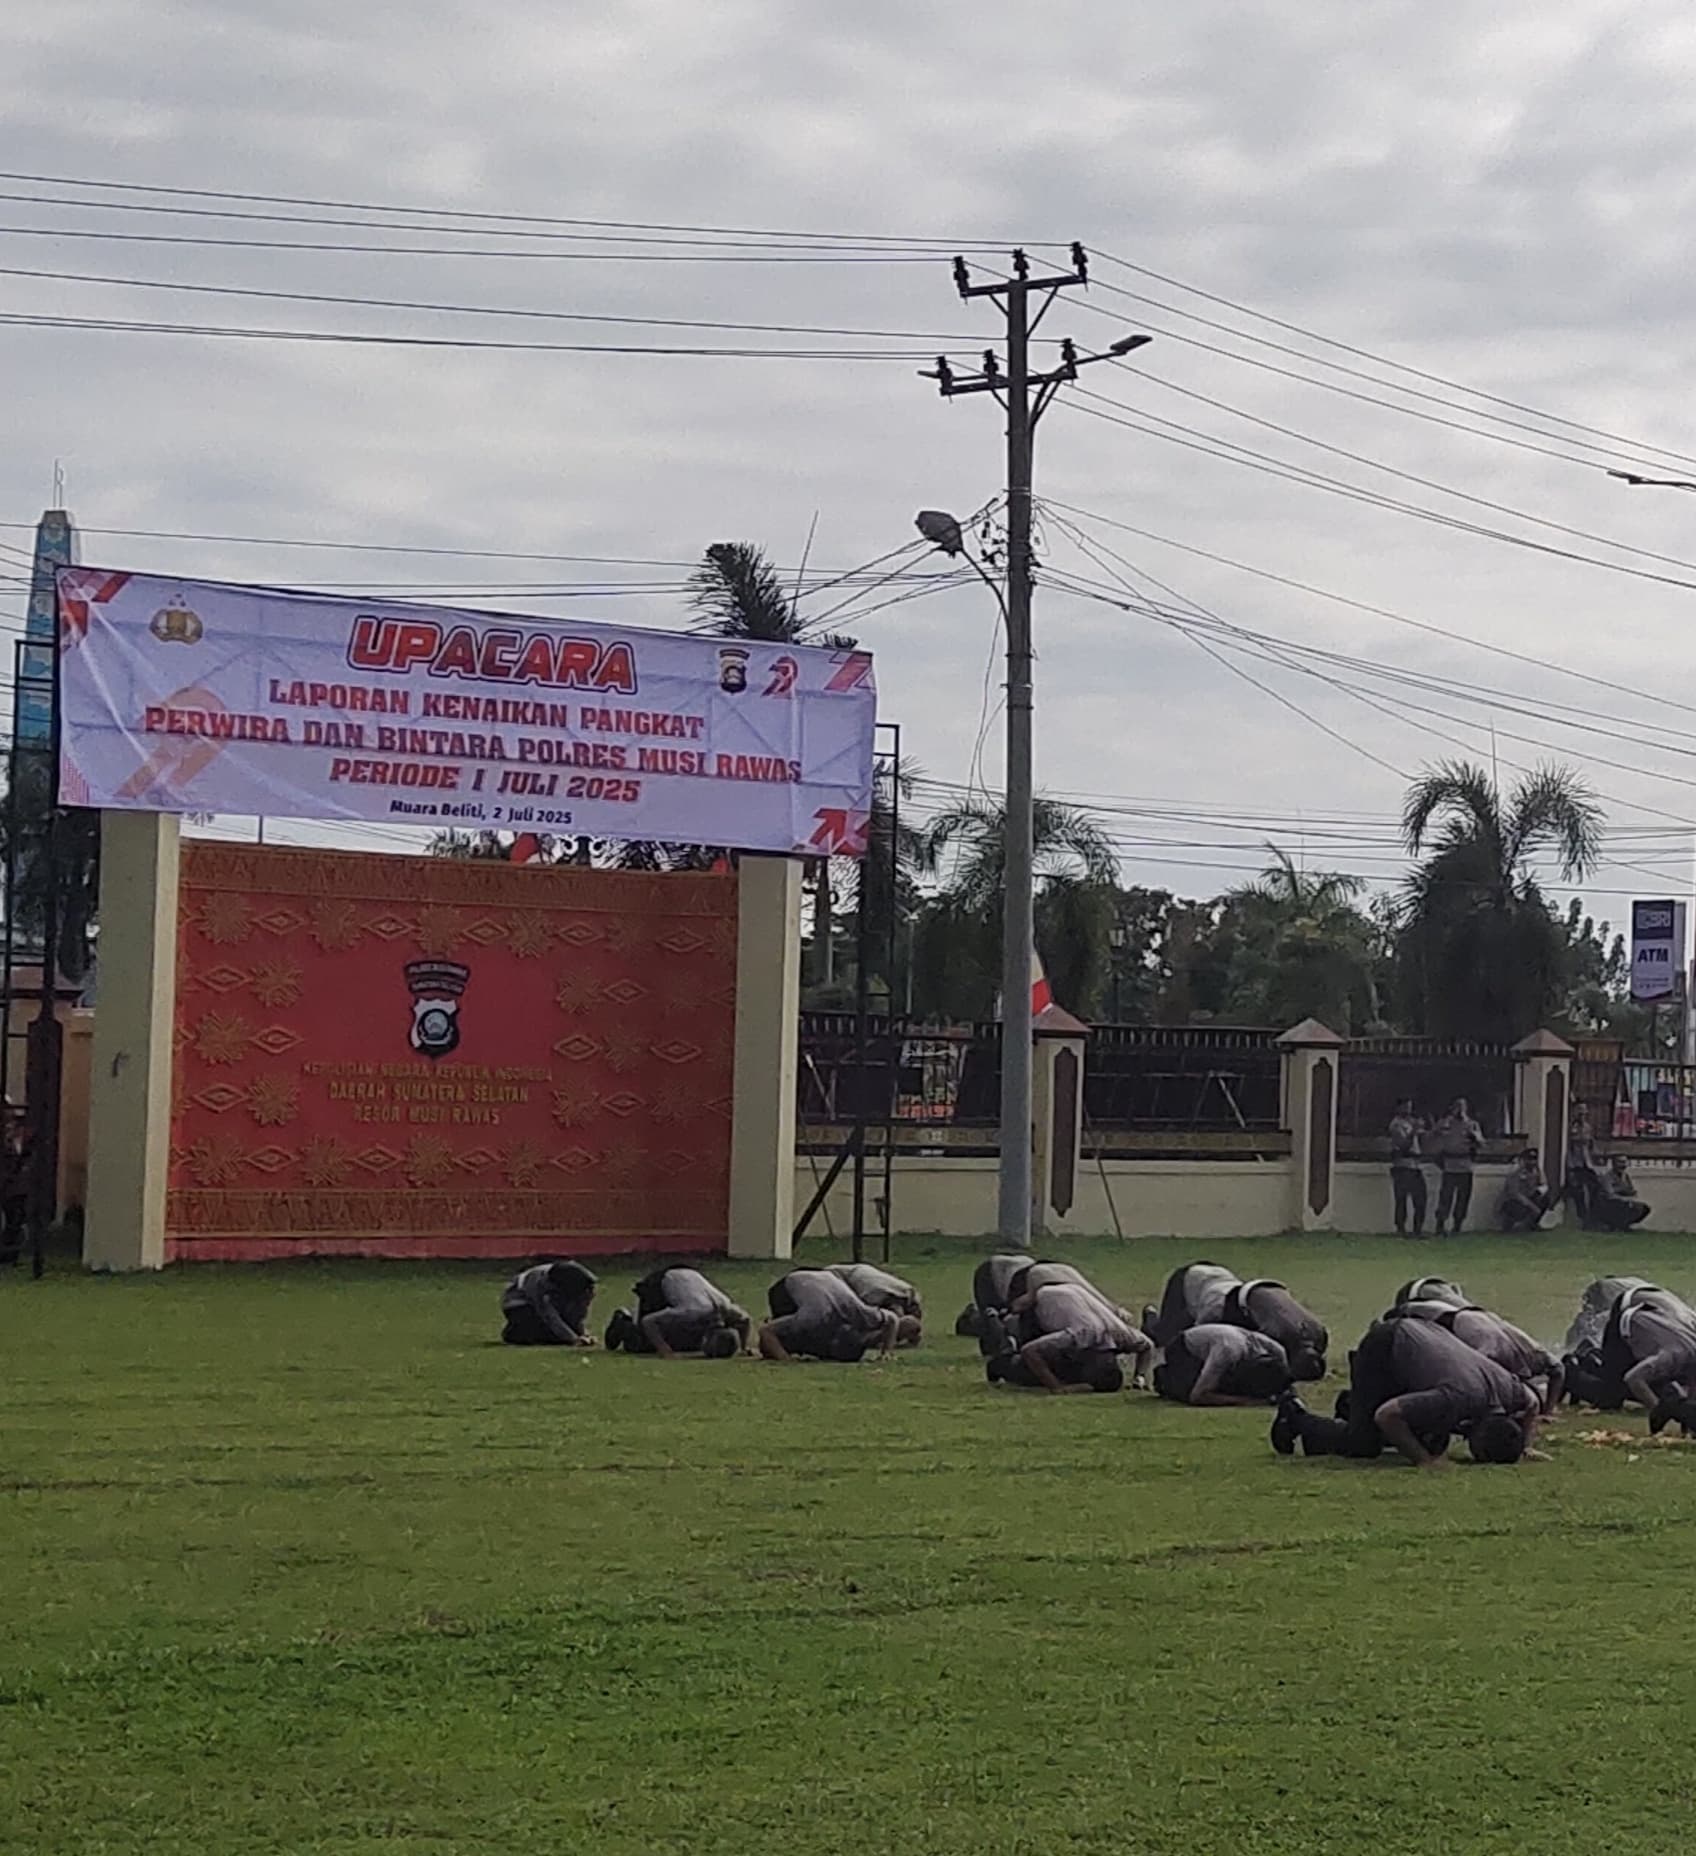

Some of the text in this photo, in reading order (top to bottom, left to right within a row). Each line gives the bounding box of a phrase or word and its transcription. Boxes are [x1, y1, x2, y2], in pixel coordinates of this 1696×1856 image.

[348, 615, 637, 695] UPACARA
[269, 679, 704, 739] LAPORAN KENAIKAN PANGKAT
[145, 707, 802, 784] PERWIRA DAN BINTARA POLRES MUSI RAWAS
[330, 758, 461, 789] PERIODE
[497, 771, 558, 796] JULI
[566, 776, 641, 802] 2025
[390, 800, 572, 824] Muara Beliti, 2 Juli 2025
[1637, 948, 1669, 963] ATM
[329, 1081, 529, 1103] DAERAH SUMATERA SELATAN
[452, 1105, 500, 1125] RAWAS
